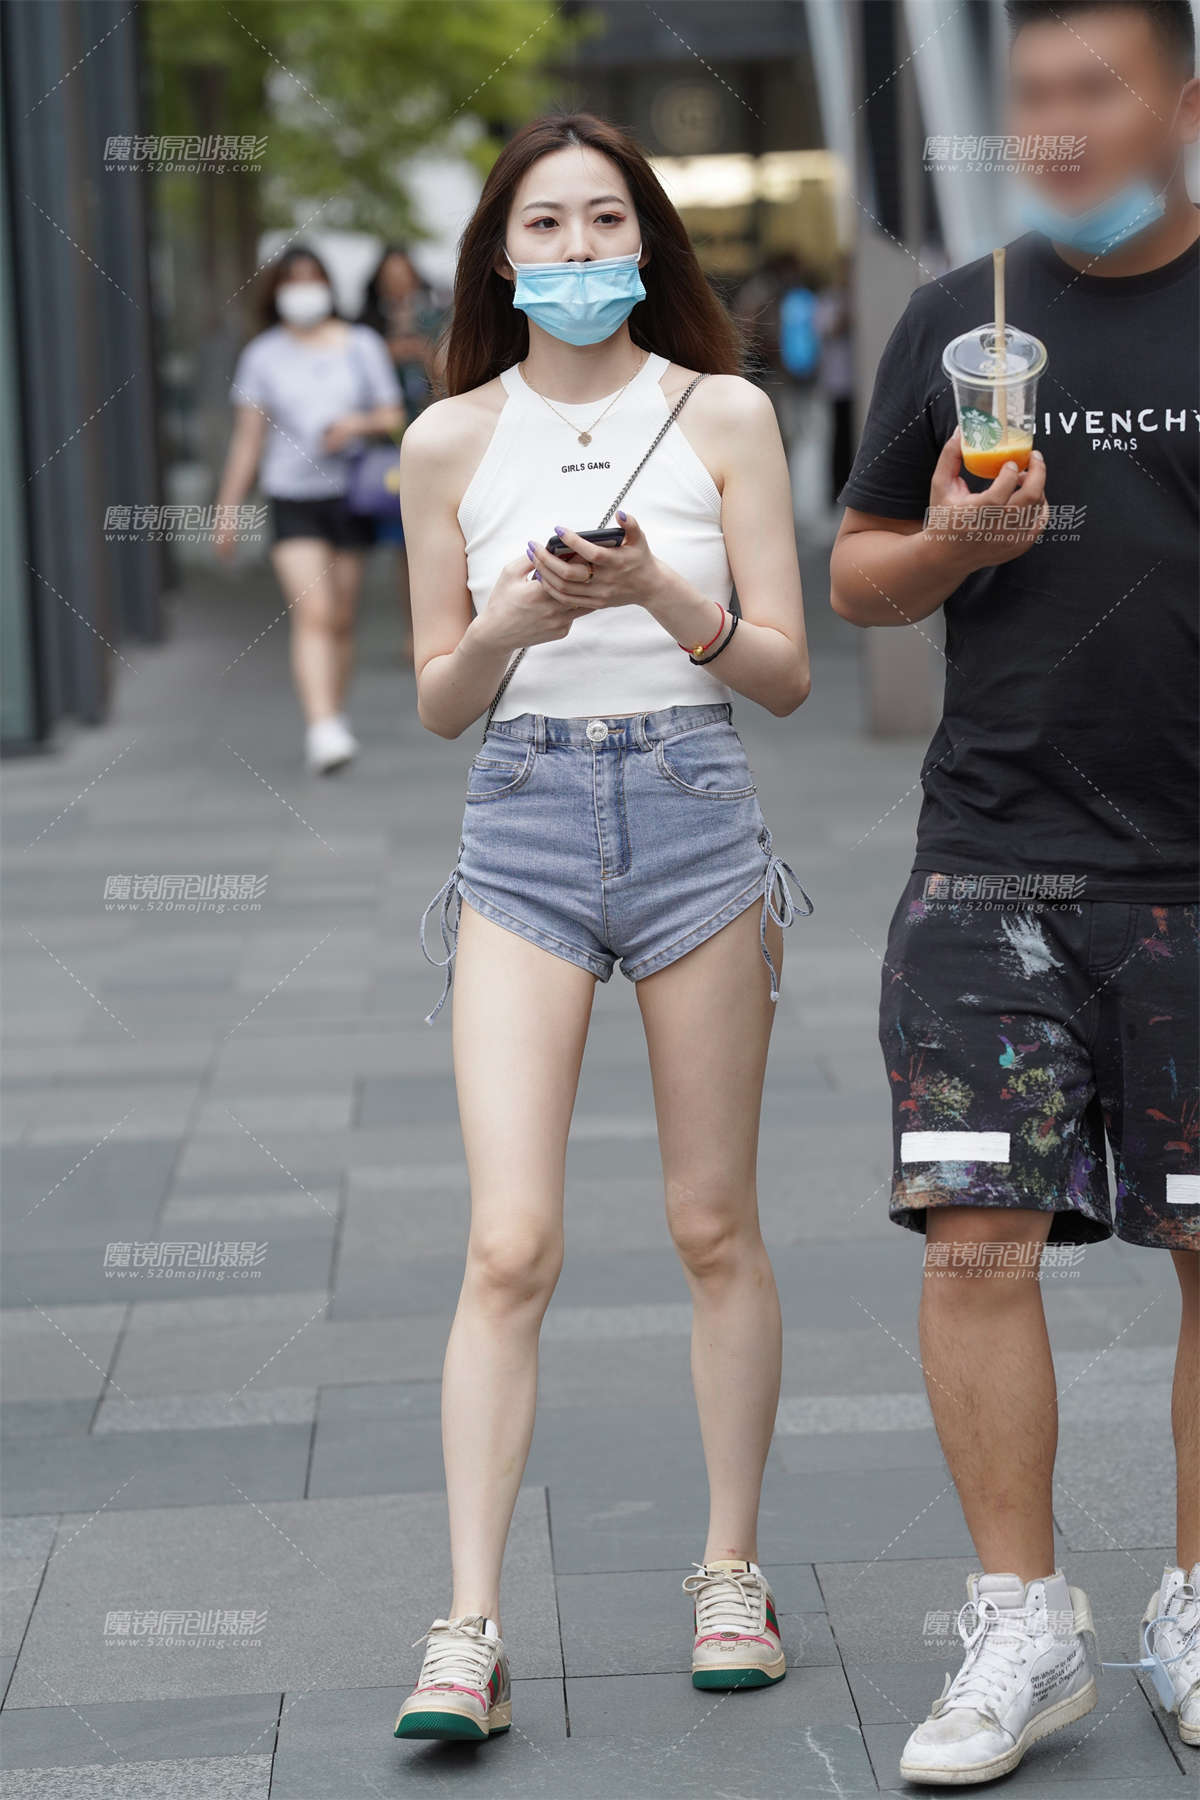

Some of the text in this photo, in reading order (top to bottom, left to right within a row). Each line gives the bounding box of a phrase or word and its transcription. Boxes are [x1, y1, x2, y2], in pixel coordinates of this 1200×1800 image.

[1092, 438, 1138, 451] PARIS
[561, 461, 610, 473] GIRLS GANG
